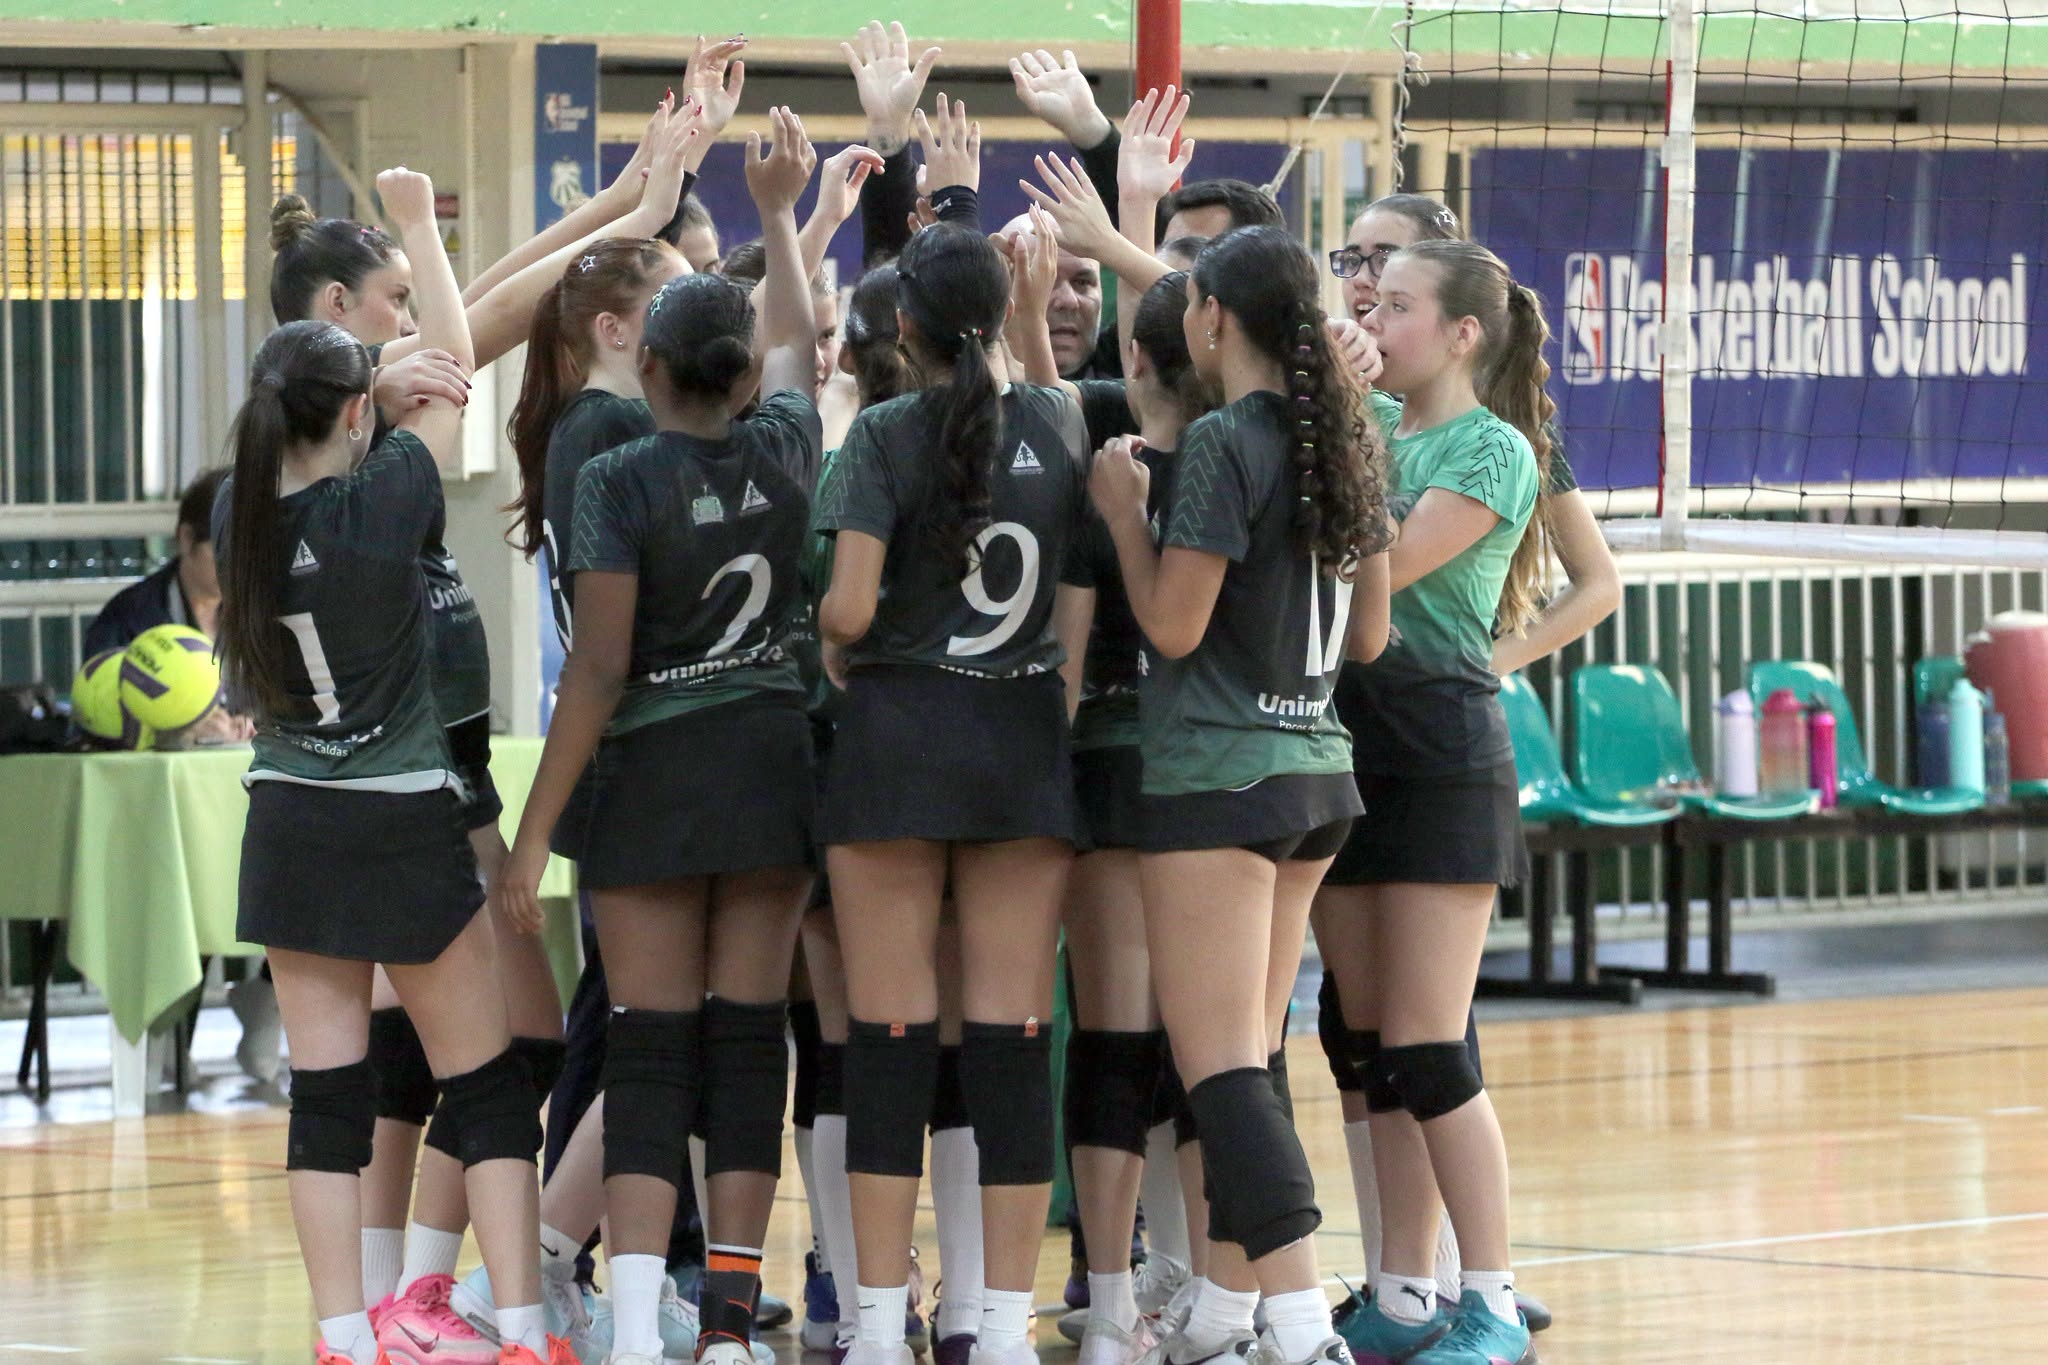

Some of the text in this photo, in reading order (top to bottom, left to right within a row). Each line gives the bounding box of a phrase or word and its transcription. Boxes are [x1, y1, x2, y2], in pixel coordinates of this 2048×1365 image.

[1871, 252, 2028, 379] School
[700, 553, 772, 659] 2
[947, 521, 1040, 656] 9
[278, 612, 341, 726] 1
[314, 743, 349, 757] Caldas
